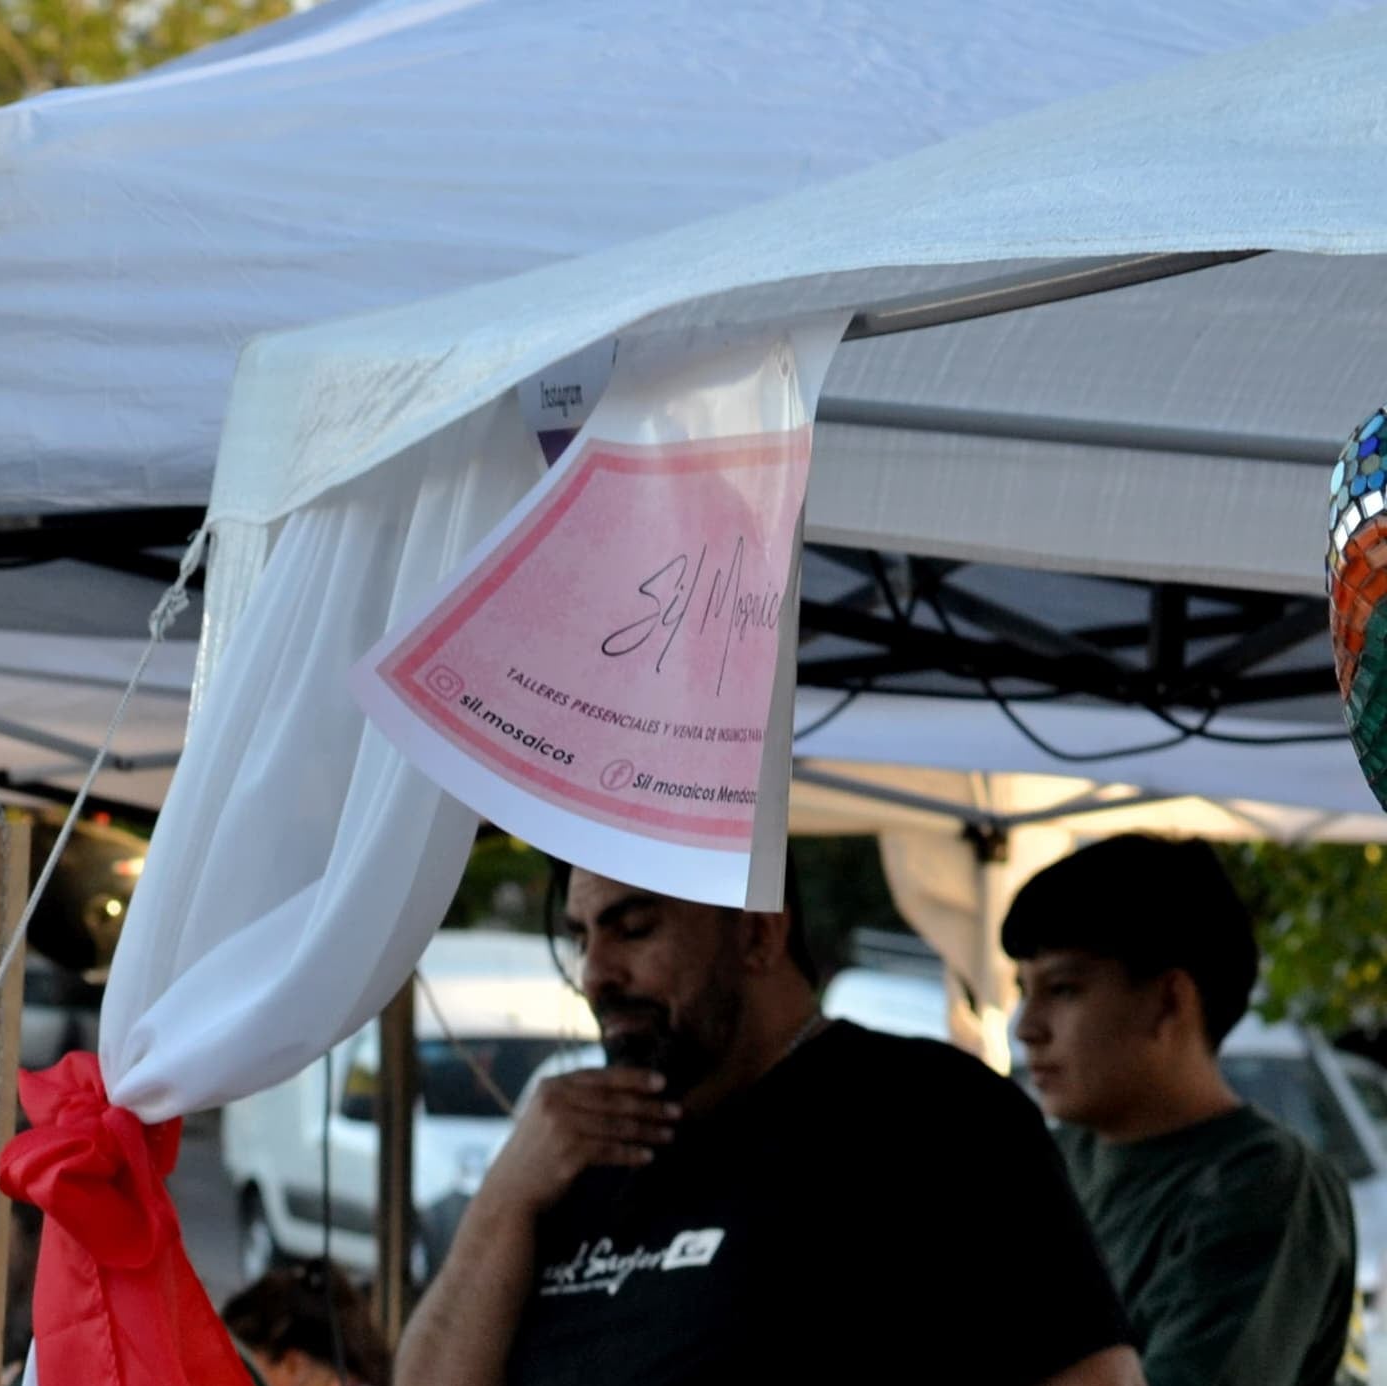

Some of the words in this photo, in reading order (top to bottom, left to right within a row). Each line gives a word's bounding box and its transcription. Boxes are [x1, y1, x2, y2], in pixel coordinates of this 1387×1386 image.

[540, 381, 583, 417] Instagram
[602, 545, 707, 674] Sil
[459, 694, 575, 766] sil.mosaicos
[506, 667, 569, 706] TALLERES
[571, 701, 661, 735] PRESENCIALES
[663, 722, 671, 735] Y
[673, 724, 704, 742] VENTA
[705, 727, 716, 742] DE
[632, 772, 652, 790] Sil
[653, 778, 716, 802] mosaicos
